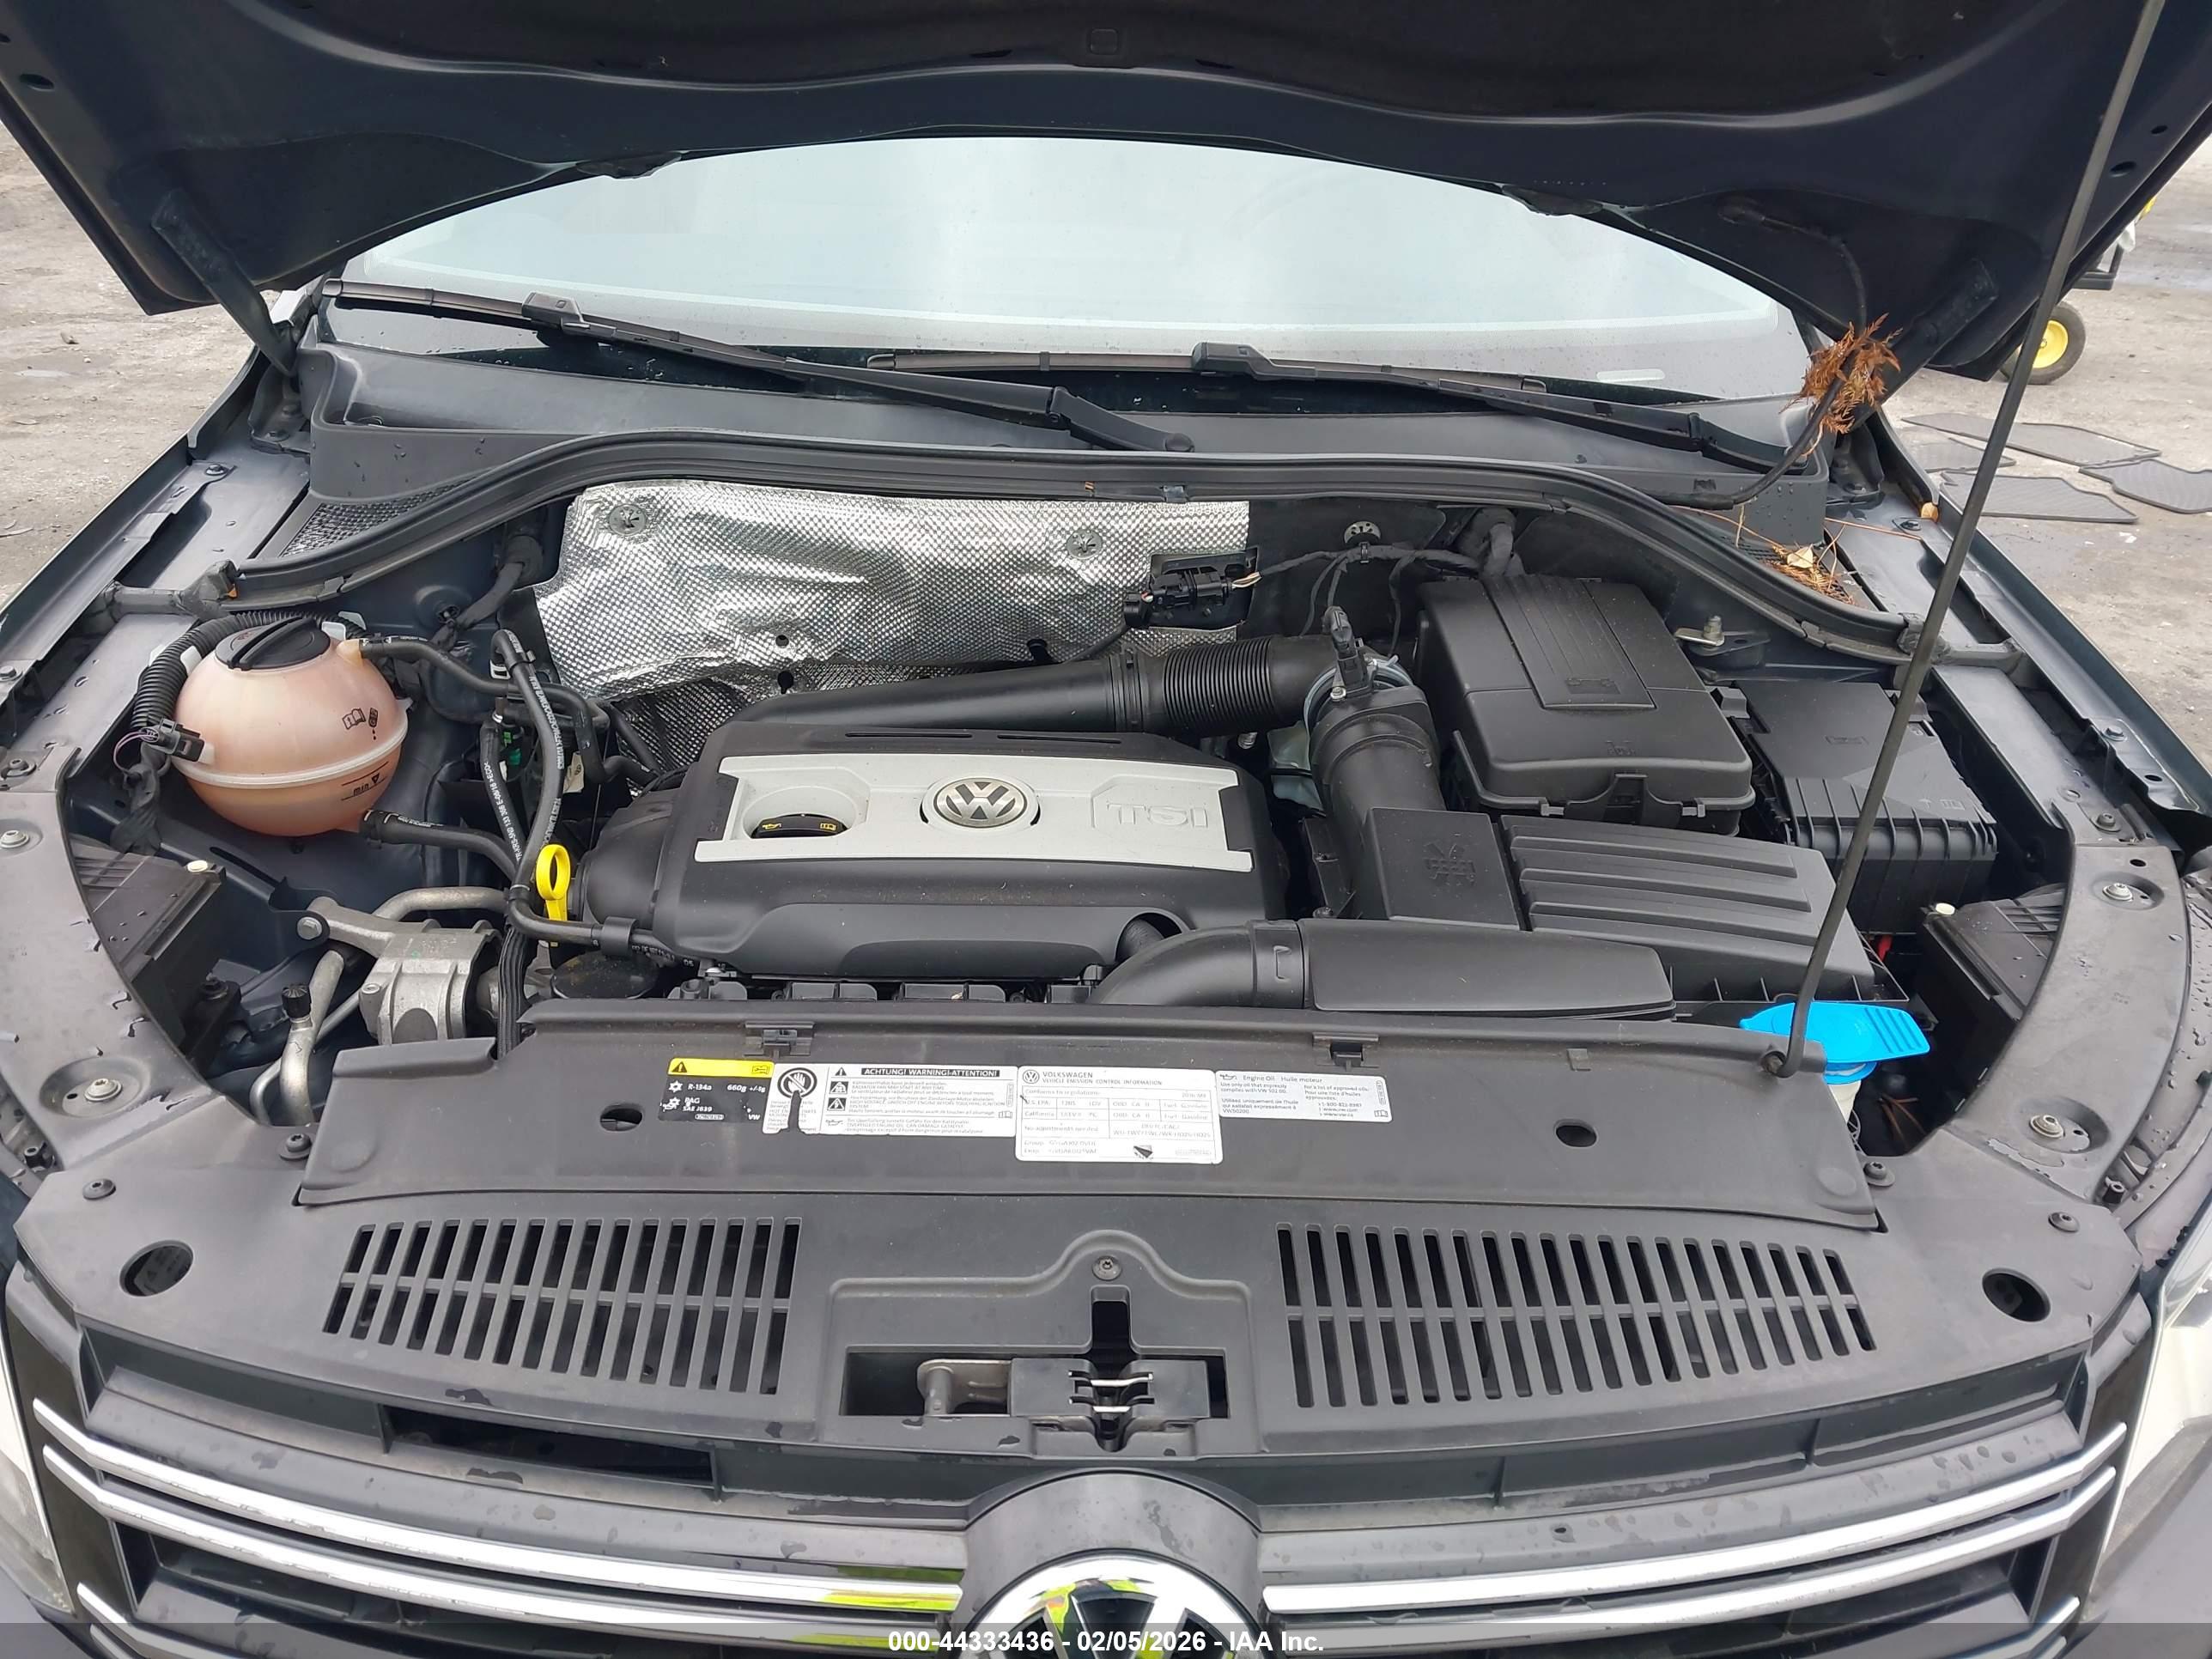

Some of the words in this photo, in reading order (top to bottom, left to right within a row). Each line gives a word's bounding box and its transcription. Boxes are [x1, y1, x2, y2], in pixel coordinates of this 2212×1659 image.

[353, 782, 369, 796] min
[1106, 803, 1208, 828] TSI
[726, 1084, 747, 1093] 660g
